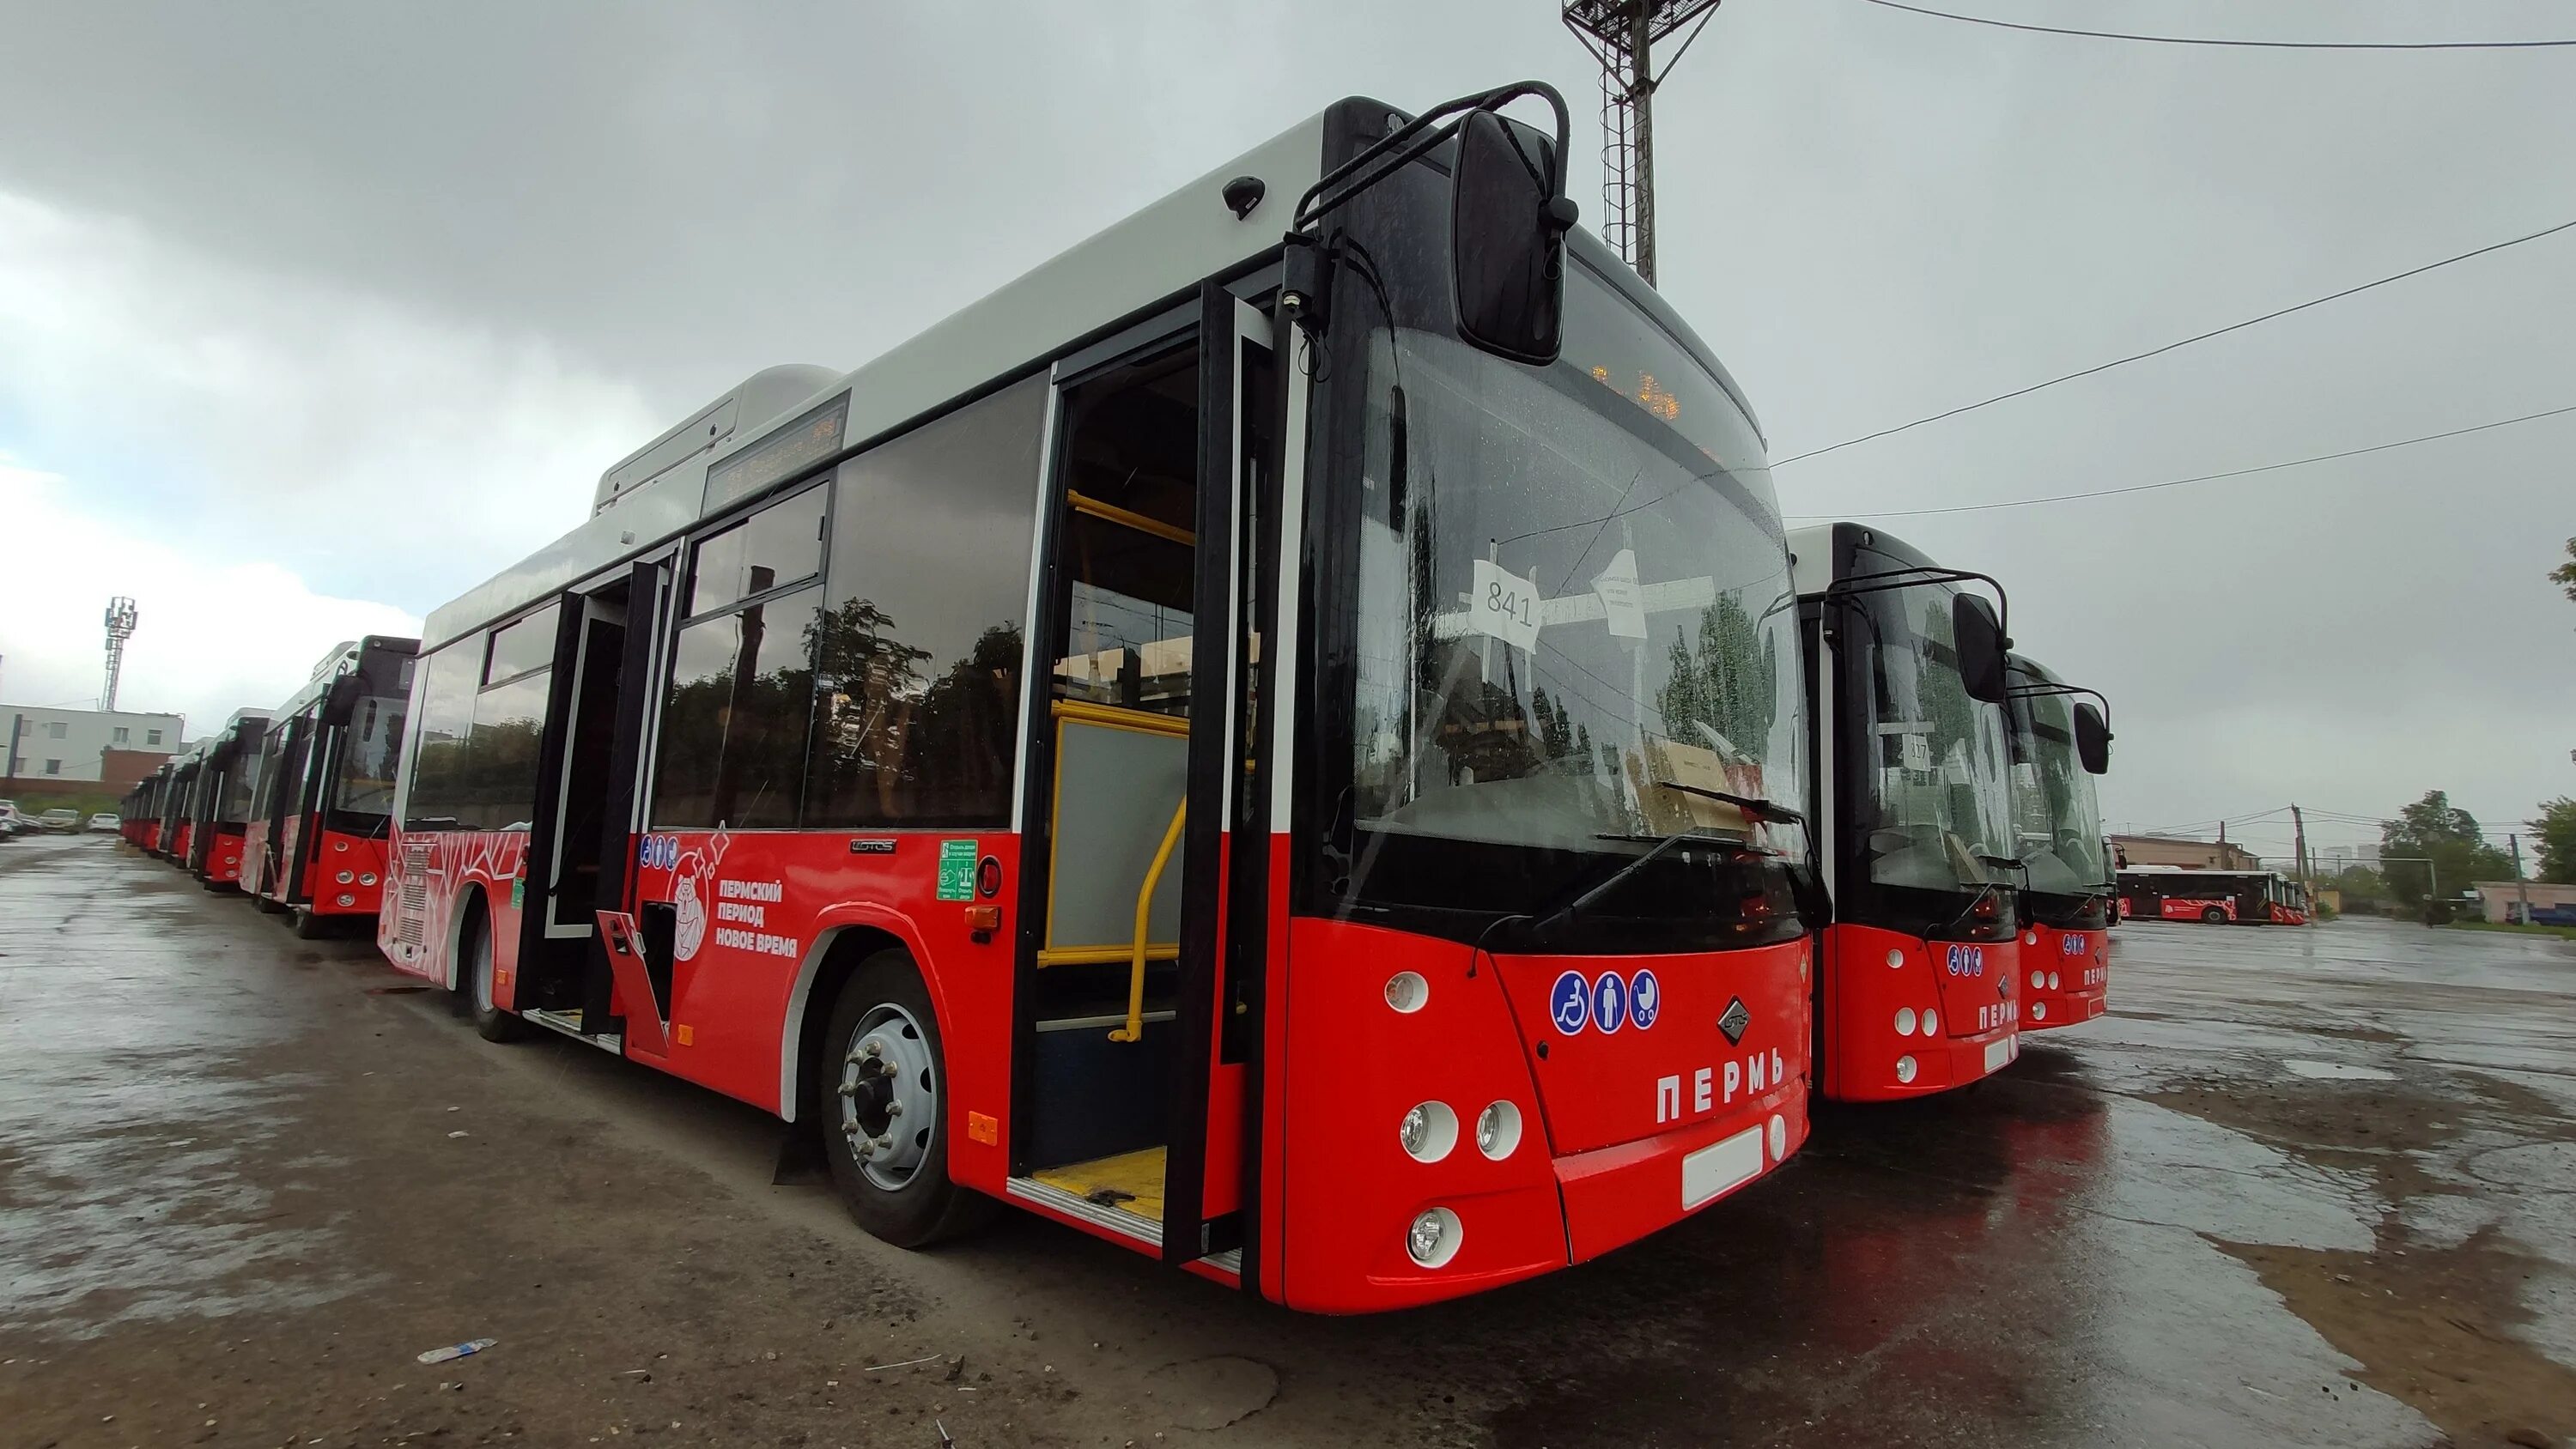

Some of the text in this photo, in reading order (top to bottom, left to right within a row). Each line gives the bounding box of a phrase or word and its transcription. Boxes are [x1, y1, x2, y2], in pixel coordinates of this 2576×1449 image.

[1487, 581, 1533, 627] 841
[1911, 742, 1927, 759] 827
[719, 879, 783, 903] ПЕРМСКИЙ
[717, 902, 764, 928] ПЕРИОД
[715, 927, 798, 958] НОВОЕ ВРЕМЯ
[1656, 1046, 1783, 1124] ПЕРМЬ
